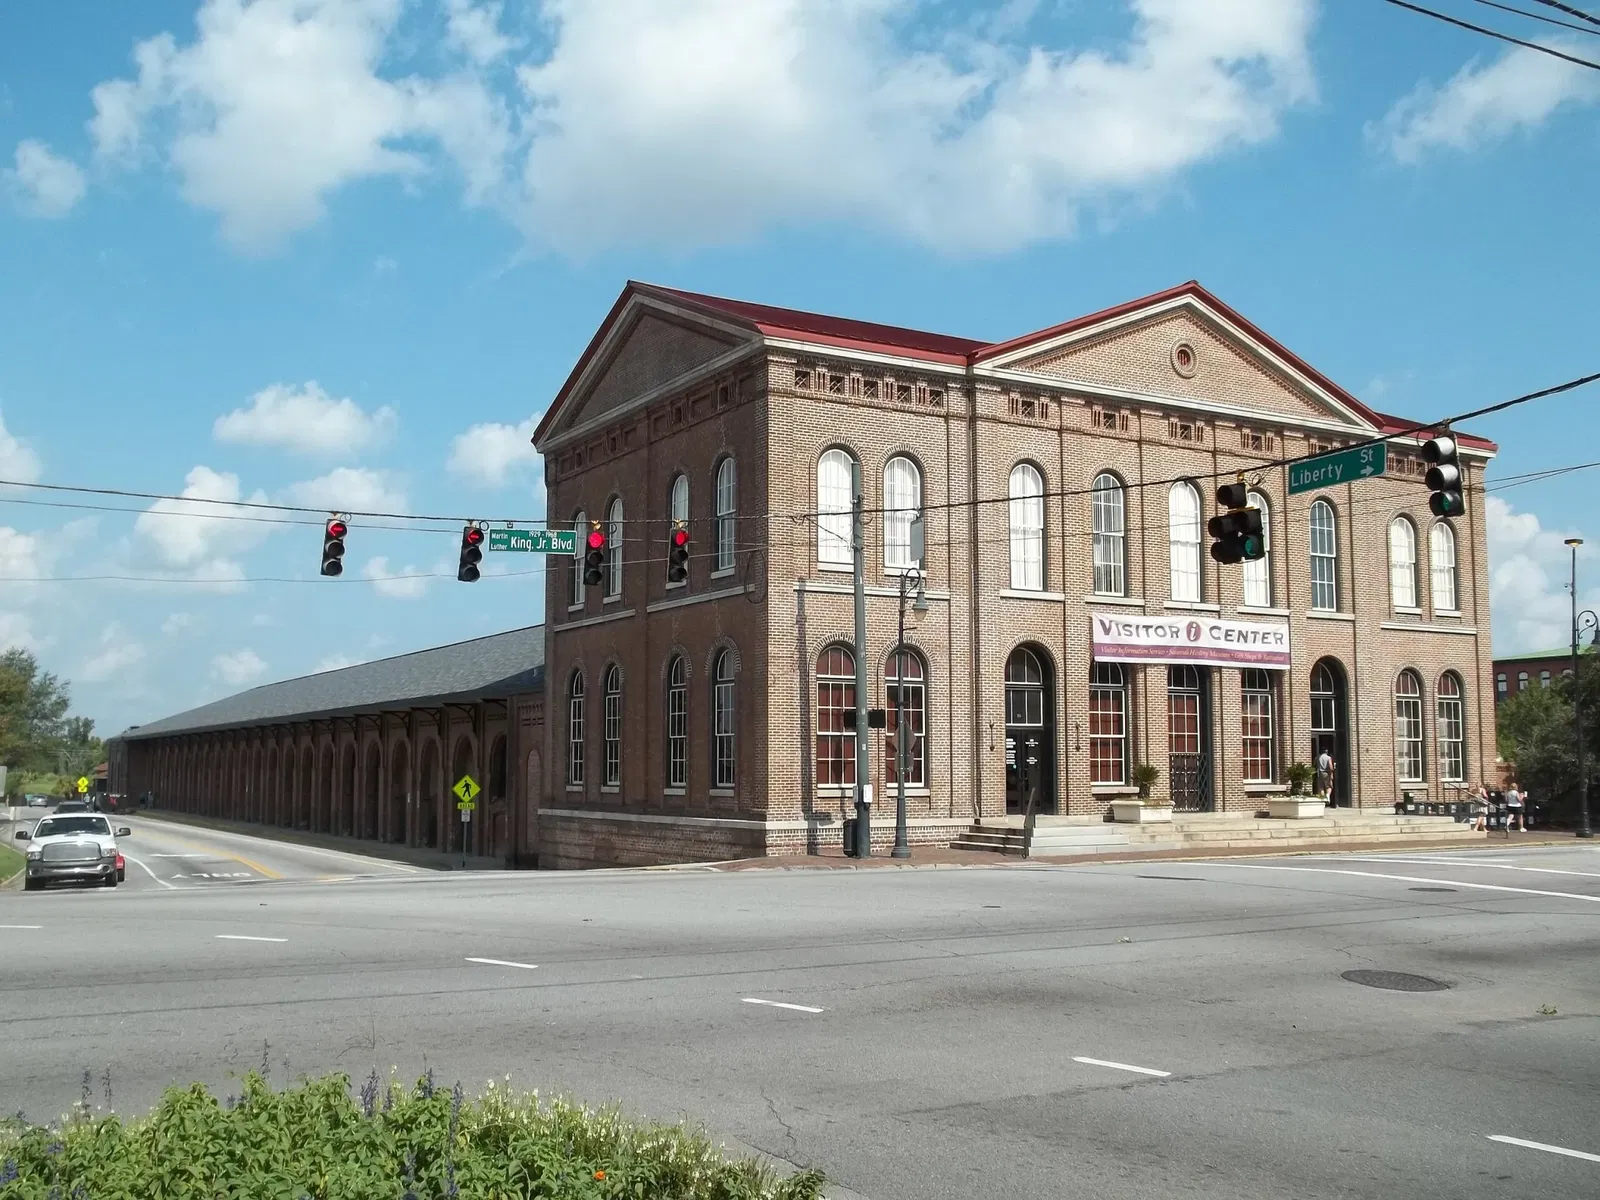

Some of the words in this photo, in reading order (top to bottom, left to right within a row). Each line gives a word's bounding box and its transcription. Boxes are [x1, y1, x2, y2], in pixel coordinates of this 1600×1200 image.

[1291, 463, 1343, 487] Liberty
[1360, 448, 1374, 464] St
[491, 532, 509, 540] Martin
[536, 537, 548, 549] Jr.
[551, 538, 574, 550] Blvd.
[1101, 645, 1118, 654] Visitor
